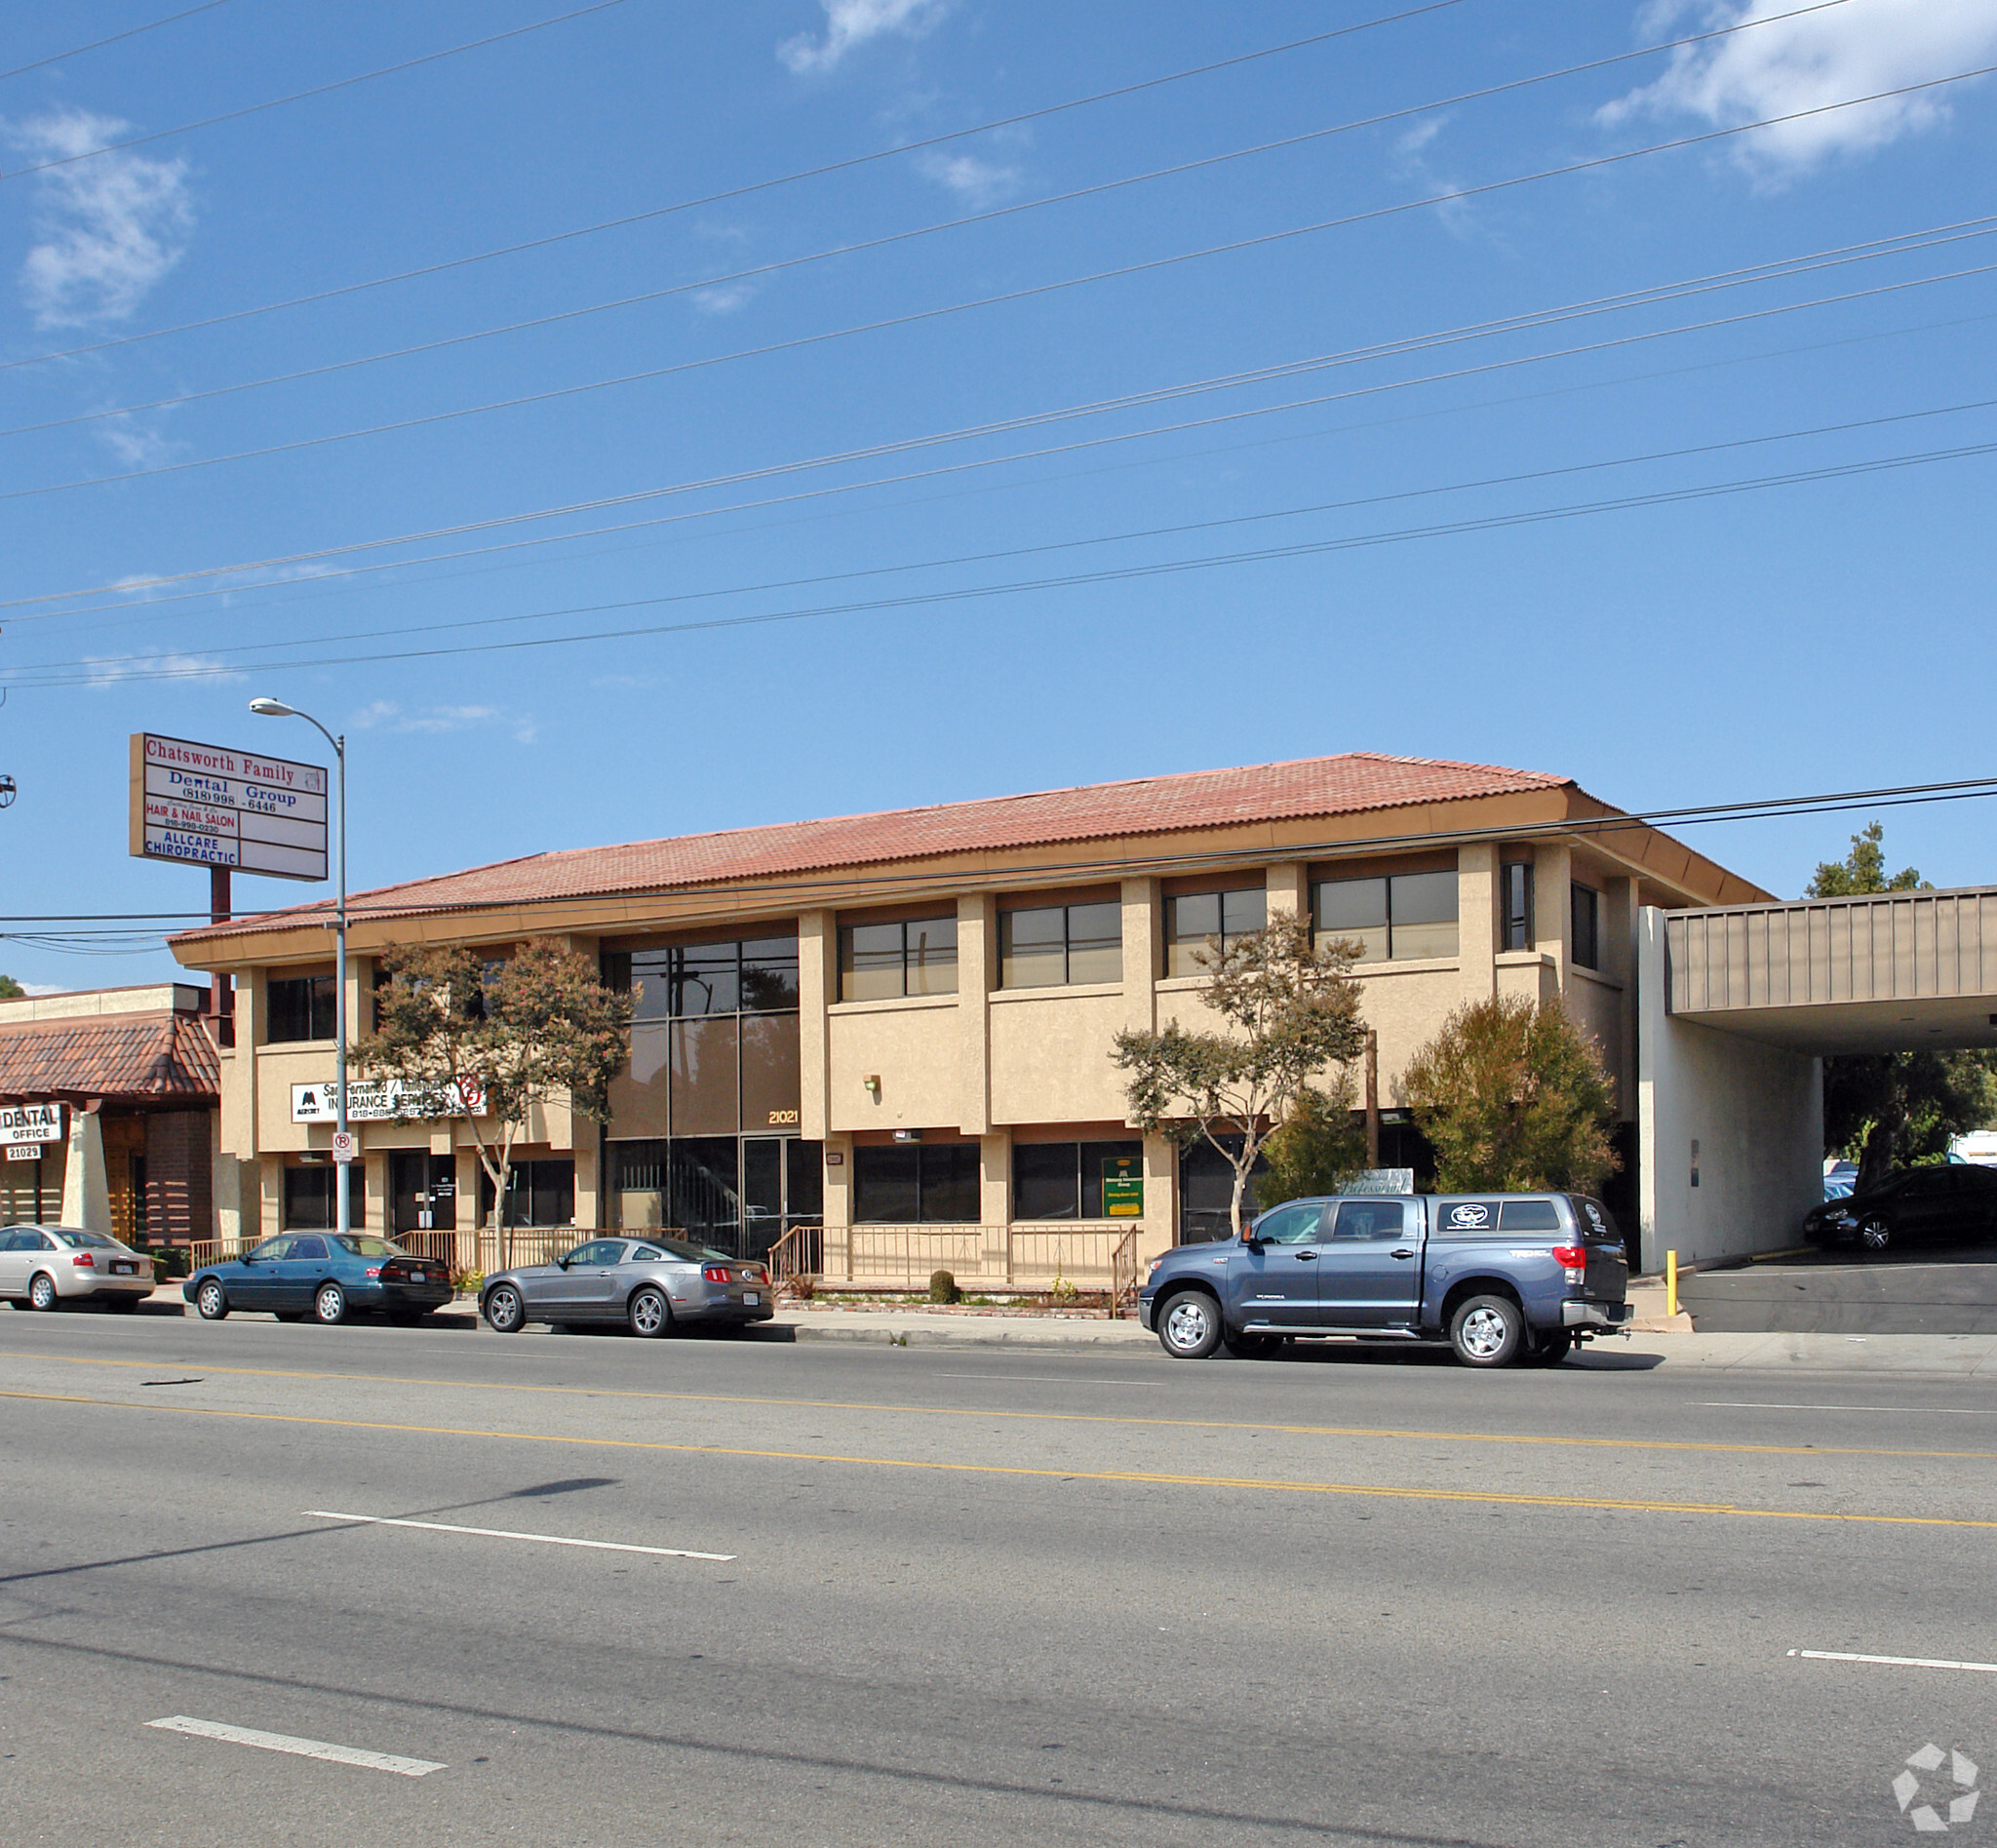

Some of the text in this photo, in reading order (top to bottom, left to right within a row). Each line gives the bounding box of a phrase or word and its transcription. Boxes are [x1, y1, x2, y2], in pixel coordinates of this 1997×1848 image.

[146, 739, 294, 786] Chatsworth Family
[169, 770, 296, 807] Dental Group
[146, 803, 235, 827] HAIR & NAIL SALON
[164, 832, 218, 849] ALLCARE
[145, 841, 236, 864] CHIROPRACTIC
[328, 1094, 388, 1110] INURANCE
[3, 1108, 58, 1128] DENTAL
[768, 1110, 799, 1124] 21021
[13, 1127, 50, 1139] OFFICE
[9, 1147, 38, 1159] 21029
